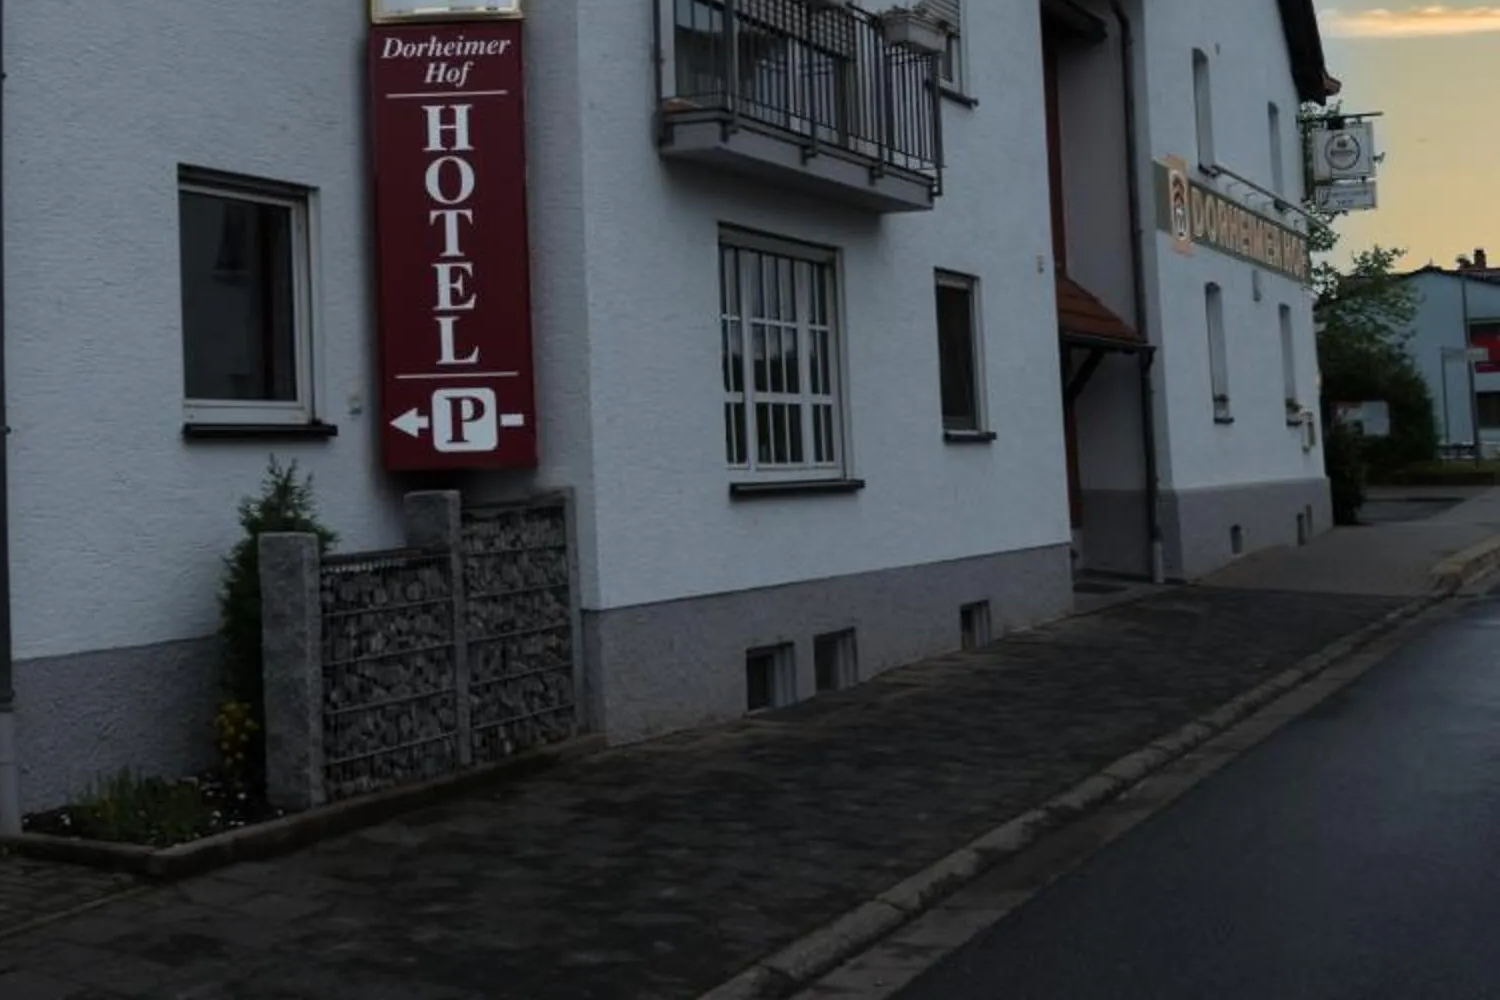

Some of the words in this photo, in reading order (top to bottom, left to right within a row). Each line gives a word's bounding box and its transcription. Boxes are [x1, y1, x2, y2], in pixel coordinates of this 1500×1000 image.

[381, 34, 511, 59] Dorheimer
[423, 61, 474, 88] Hof
[421, 103, 480, 366] HOTEL
[444, 395, 486, 444] P
